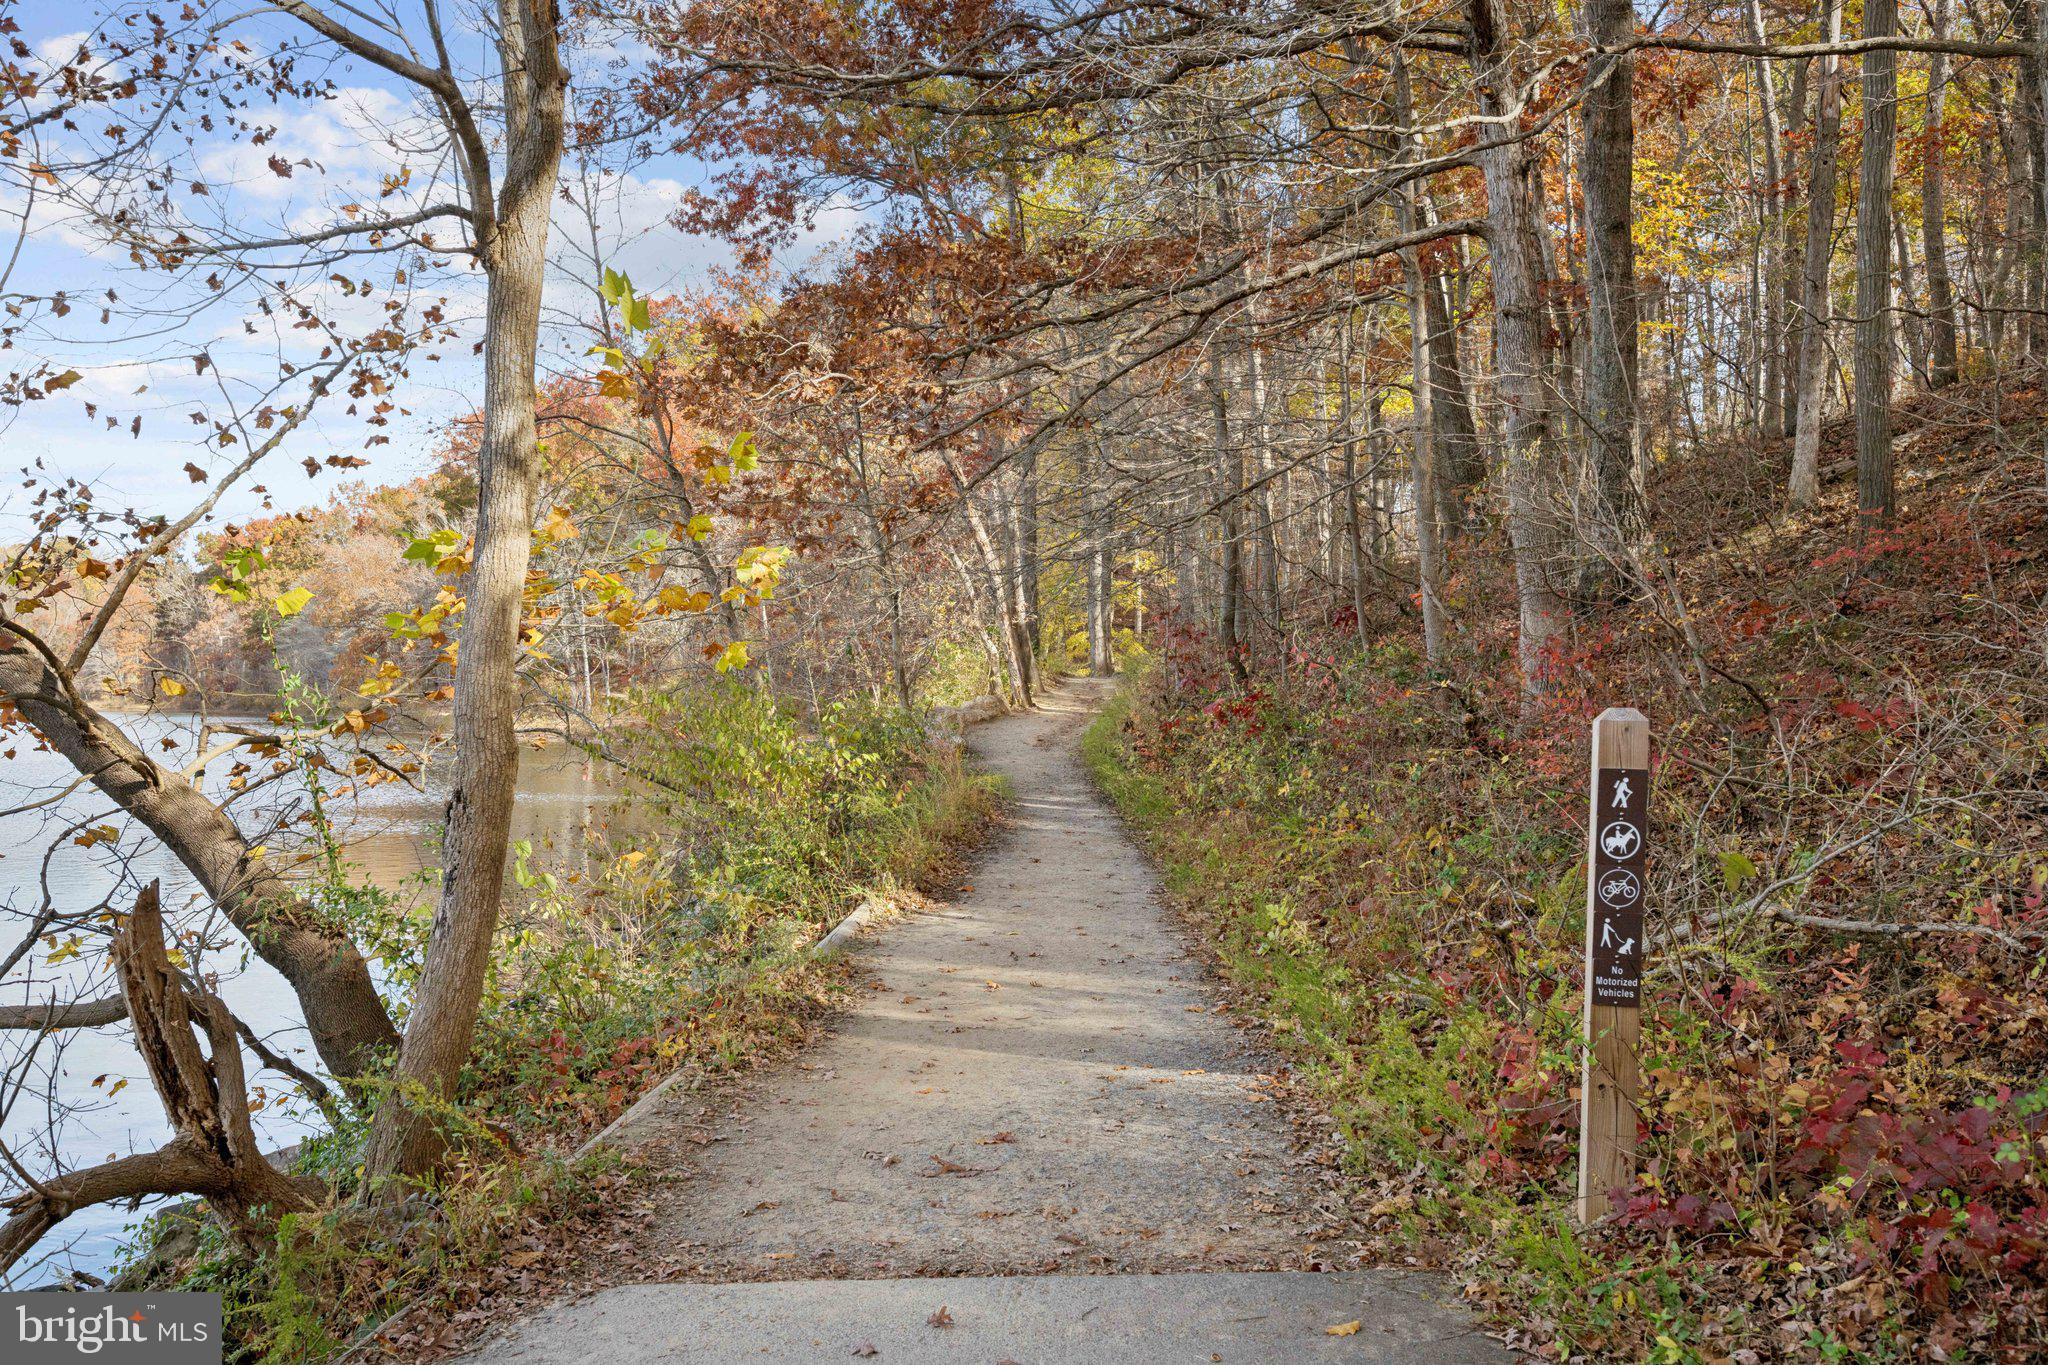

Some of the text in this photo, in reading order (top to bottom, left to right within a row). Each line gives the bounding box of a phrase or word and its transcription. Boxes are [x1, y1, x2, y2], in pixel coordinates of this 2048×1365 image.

[1611, 966, 1623, 975] No
[1595, 976, 1638, 987] Motorized
[1598, 987, 1635, 998] Vehicles
